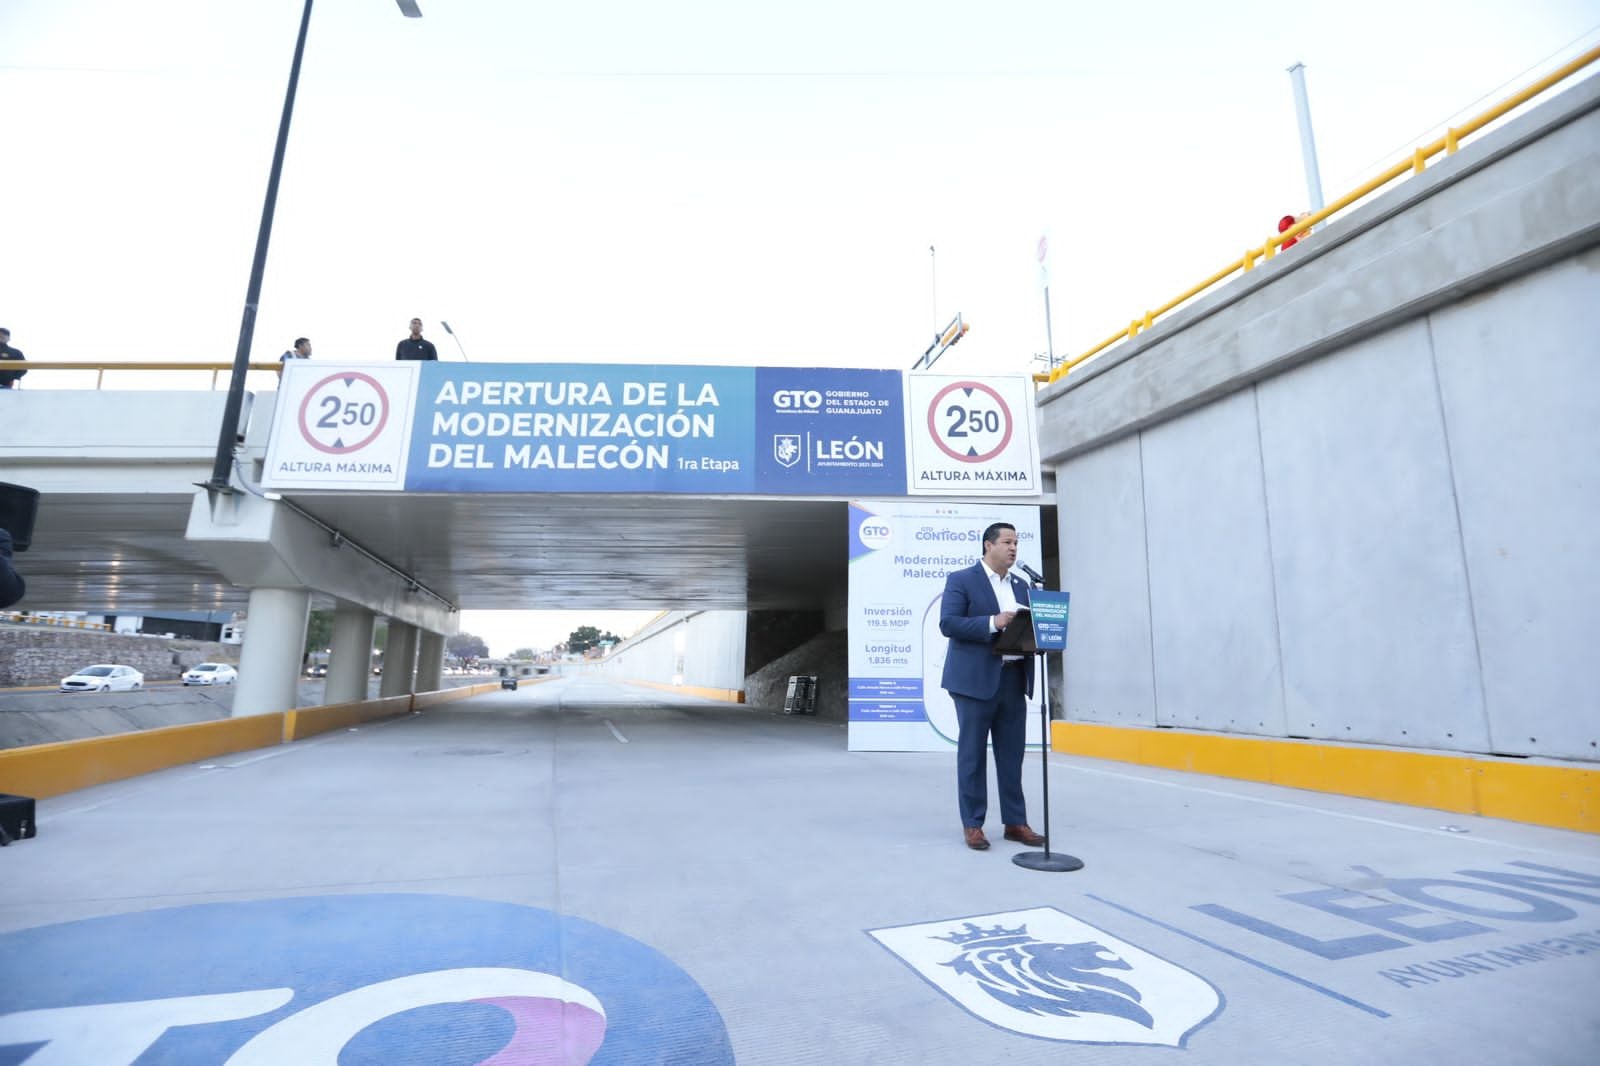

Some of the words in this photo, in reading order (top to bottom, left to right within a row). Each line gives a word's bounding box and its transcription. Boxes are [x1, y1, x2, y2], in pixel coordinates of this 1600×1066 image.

[435, 381, 613, 405] APERTURA
[623, 382, 667, 405] DE
[677, 383, 720, 406] LA
[773, 390, 822, 408] GTO
[825, 407, 882, 415] GUANAJUATO
[432, 409, 715, 438] MODERNIZACIÓN
[816, 435, 883, 460] LEÓN
[427, 443, 494, 468] DEL
[503, 440, 669, 469] MALECÓN
[677, 457, 698, 470] 1ra
[701, 457, 740, 472] Etapa
[279, 461, 332, 472] ALTURA
[336, 461, 393, 474] MÁXIMA
[920, 470, 971, 481] ALTURA
[974, 468, 1028, 481] MÁXIMA
[863, 525, 889, 537] GTO
[863, 606, 913, 617] Inversión
[865, 644, 912, 655] Longitud
